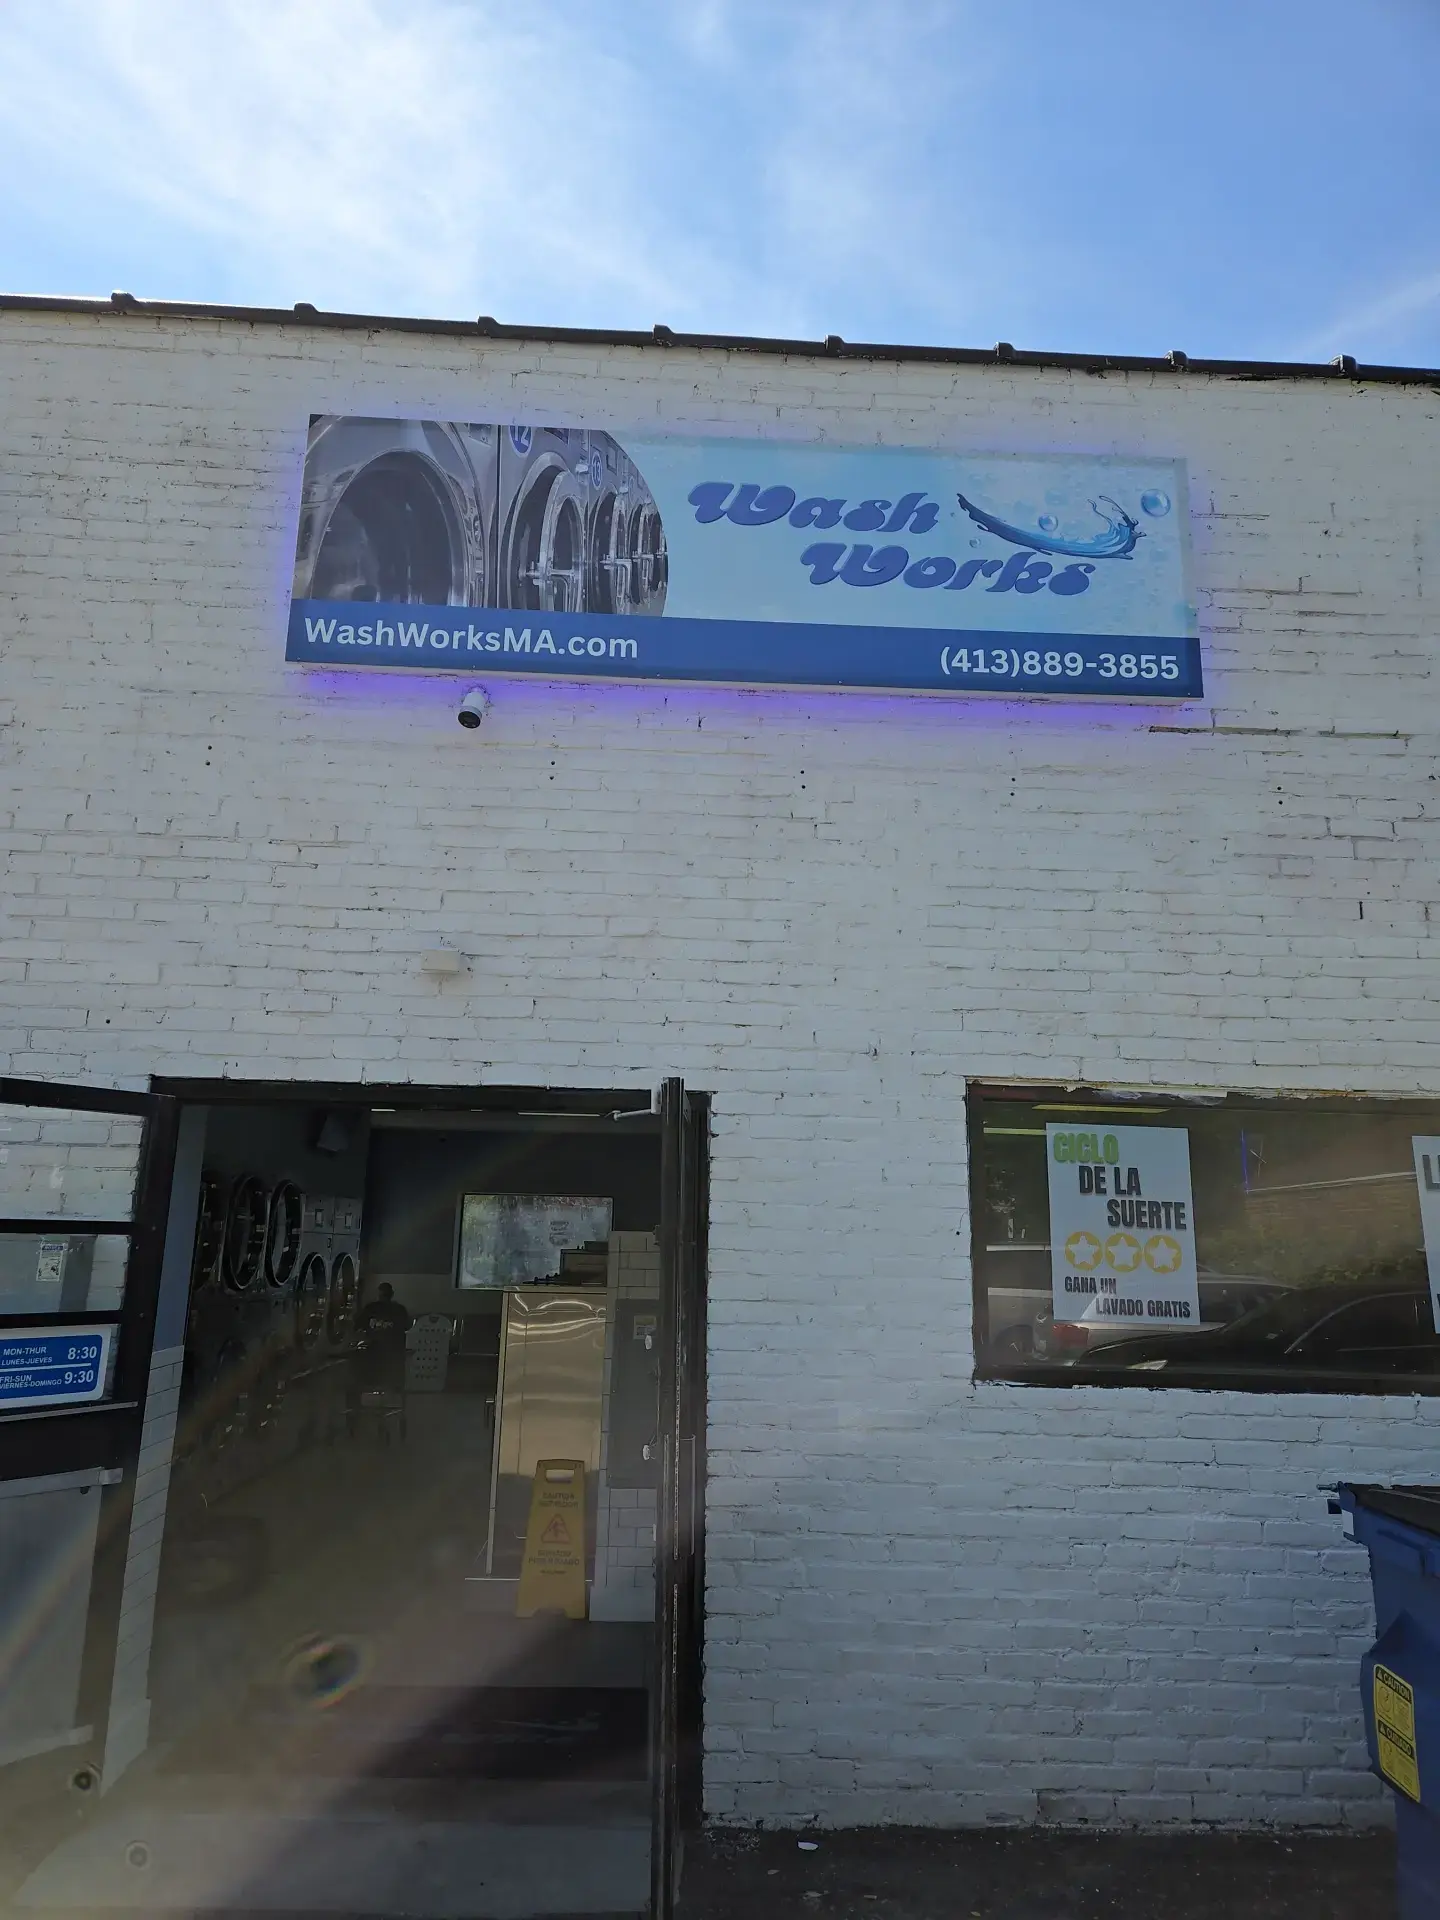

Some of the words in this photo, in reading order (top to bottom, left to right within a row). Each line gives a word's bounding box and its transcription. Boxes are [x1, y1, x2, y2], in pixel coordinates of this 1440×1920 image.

[688, 481, 940, 534] Wash
[800, 542, 1096, 596] Works
[304, 617, 638, 658] WashWorksMA.com
[941, 647, 1179, 680] (413)889-3855
[1053, 1132, 1119, 1165] CICLO
[1078, 1165, 1107, 1194] DE
[1114, 1166, 1142, 1196] LA
[1106, 1198, 1187, 1230] SUERTE
[1064, 1276, 1098, 1294] GANA
[1100, 1277, 1117, 1294] UN
[1095, 1297, 1144, 1317] LAVADO
[1147, 1299, 1191, 1319] GRATIS
[1, 1356, 53, 1366] LUNES-JUEVES
[3, 1346, 47, 1356] MON-THUR
[67, 1346, 97, 1360] 8:30
[64, 1369, 94, 1385] 9:30
[1384, 1674, 1411, 1701] CAUTION
